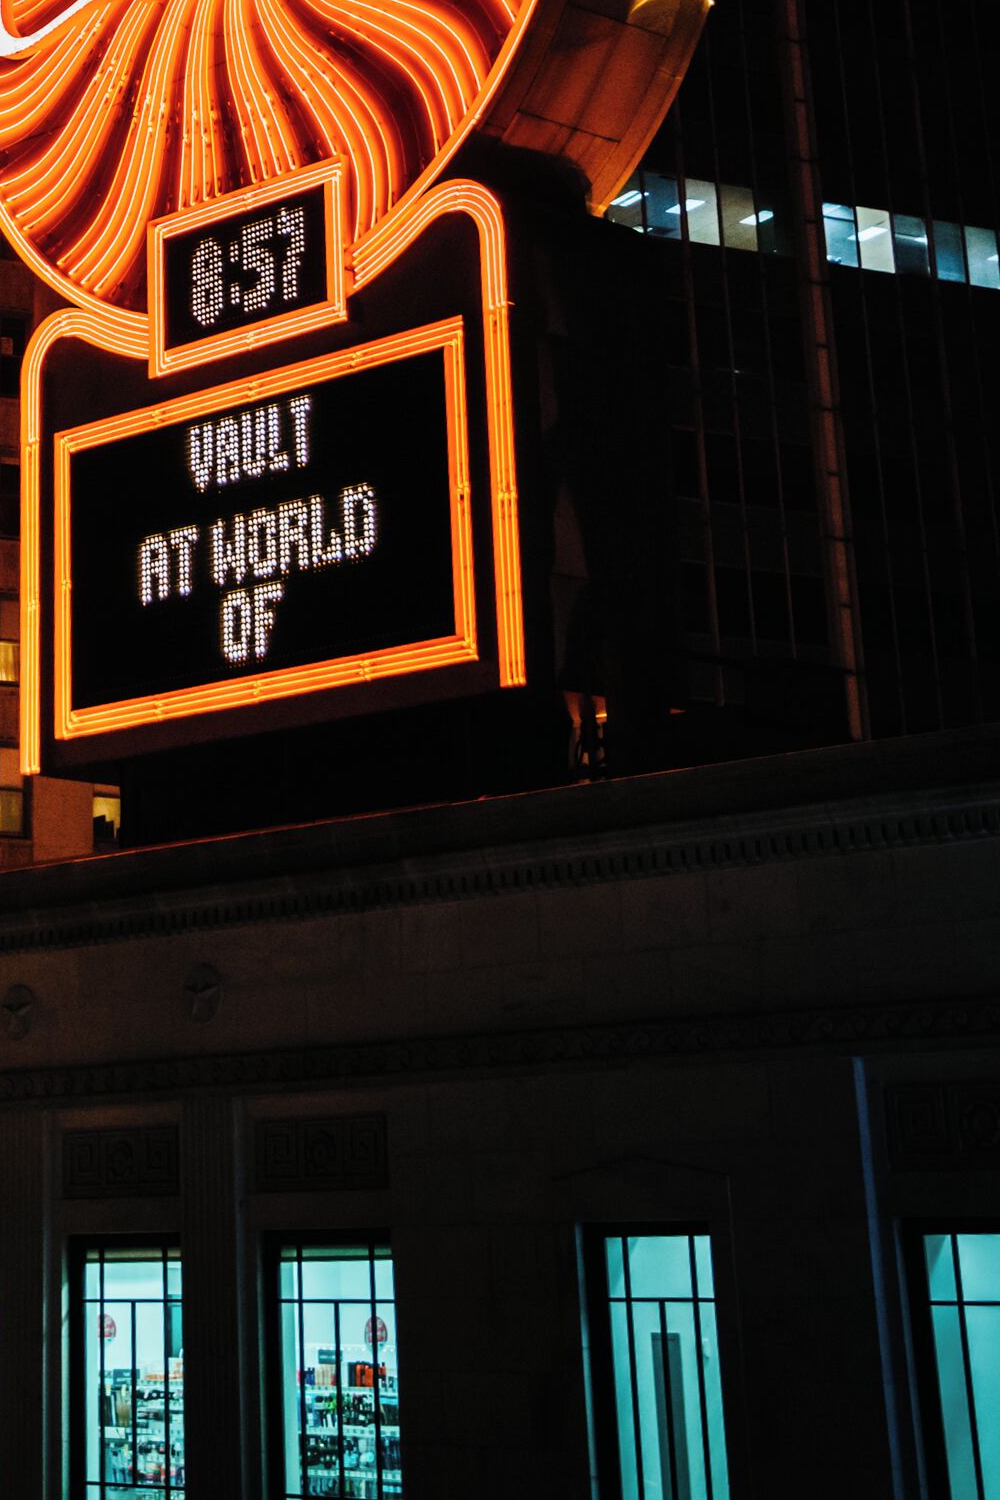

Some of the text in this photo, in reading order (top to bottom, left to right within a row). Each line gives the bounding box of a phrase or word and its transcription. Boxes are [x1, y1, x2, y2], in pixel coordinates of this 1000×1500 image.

[191, 206, 305, 326] 8:57
[187, 395, 312, 493] VAULT
[138, 483, 377, 606] AT WORLD
[220, 580, 284, 665] OF
